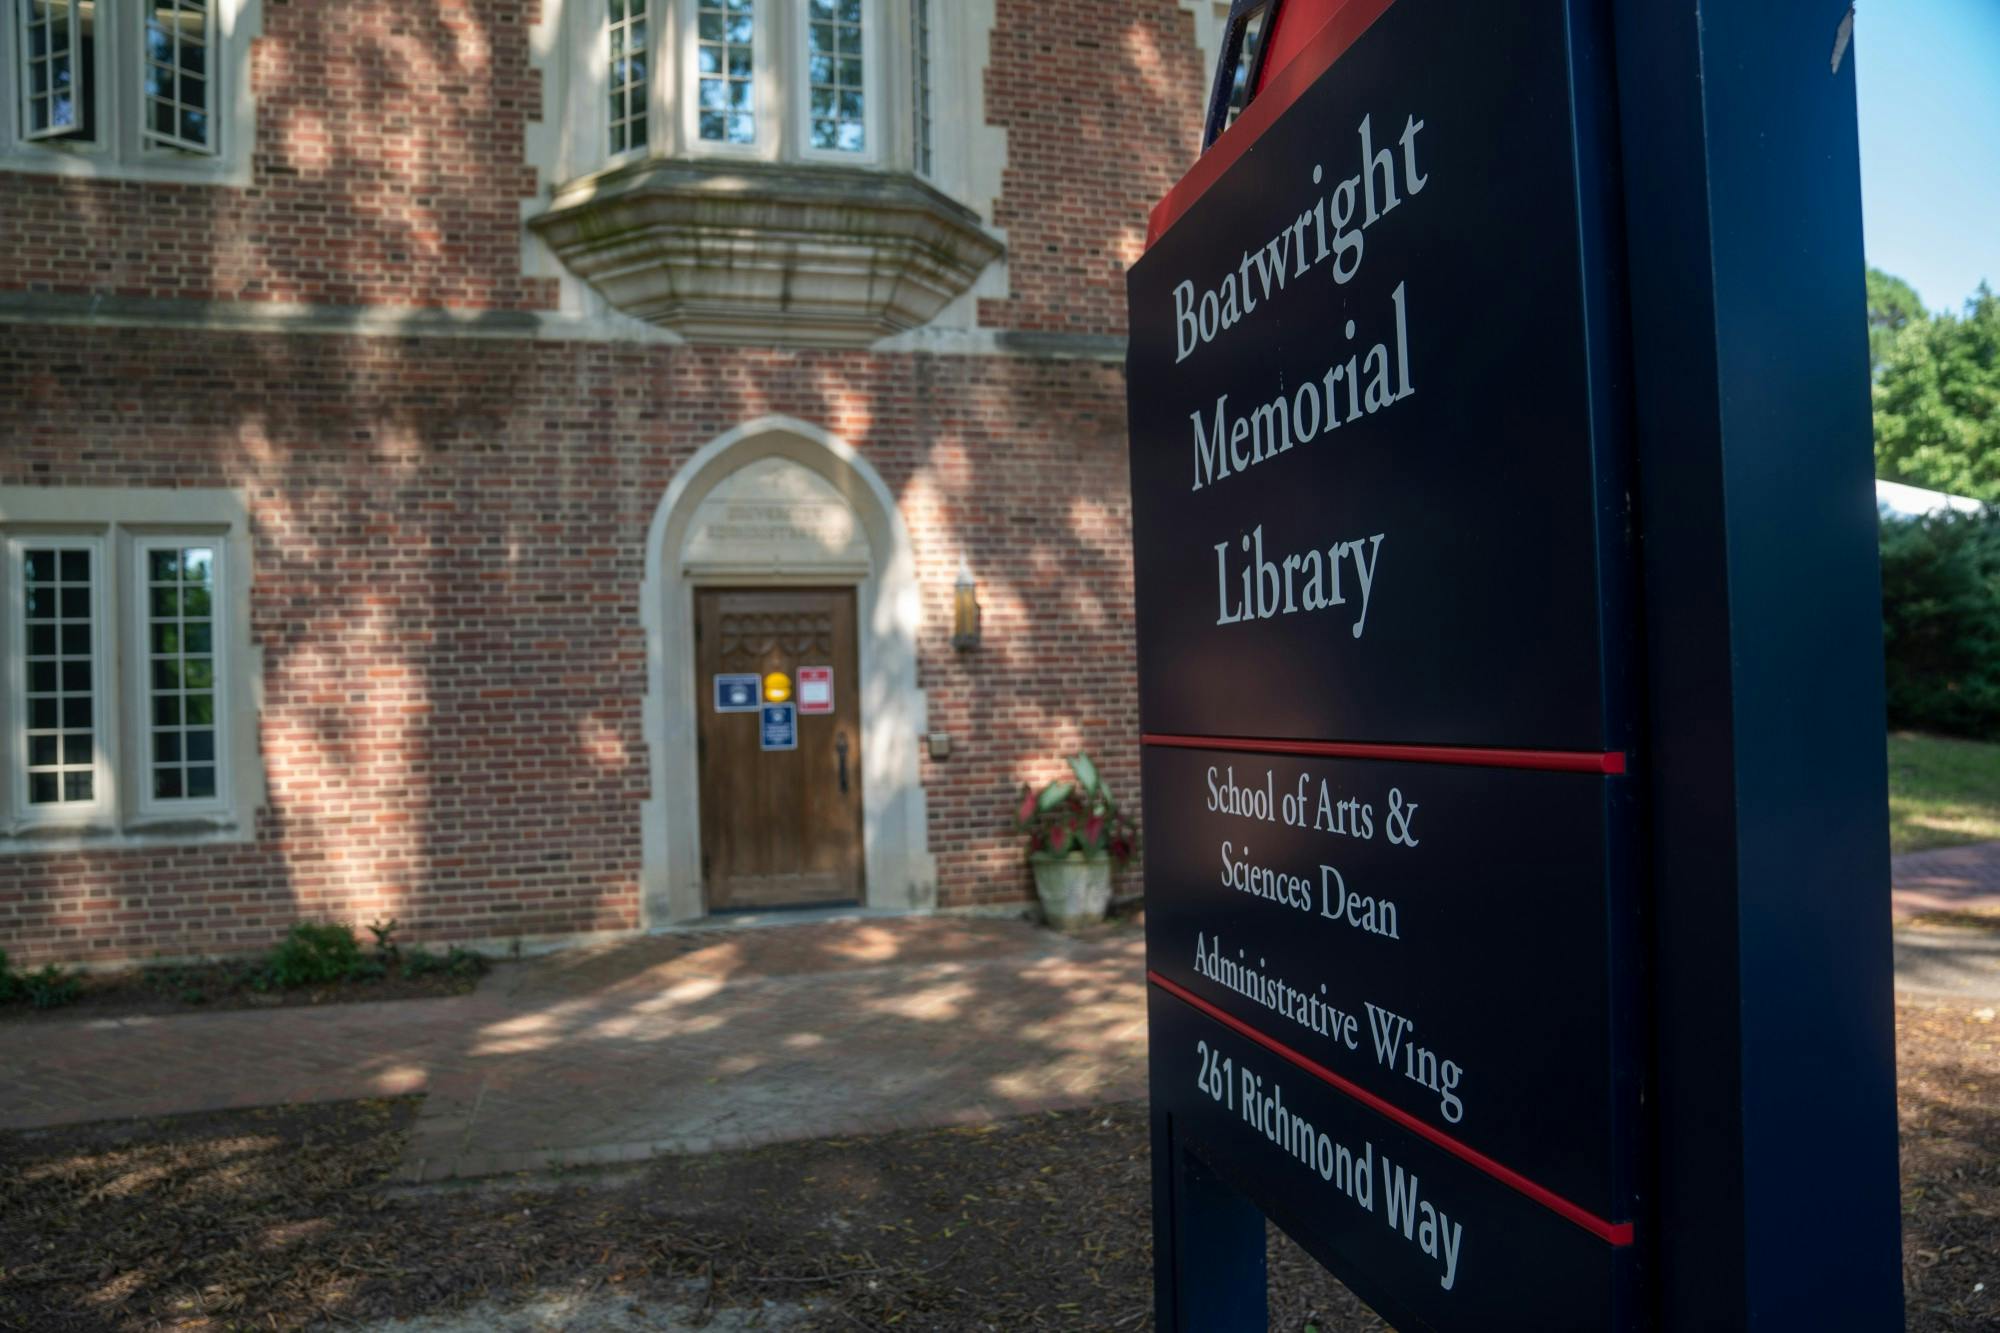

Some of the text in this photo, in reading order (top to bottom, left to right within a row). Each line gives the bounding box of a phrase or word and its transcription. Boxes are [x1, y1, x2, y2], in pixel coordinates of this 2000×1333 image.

[1172, 112, 1429, 364] Boatwright
[1190, 280, 1415, 492] Memorial
[1214, 524, 1385, 639] Library
[1206, 765, 1420, 848] School of Arts &
[1221, 840, 1400, 940] Sciences Dean
[1193, 931, 1464, 1124] Administrative Wing
[1197, 1040, 1463, 1292] 261 Richmond Way
